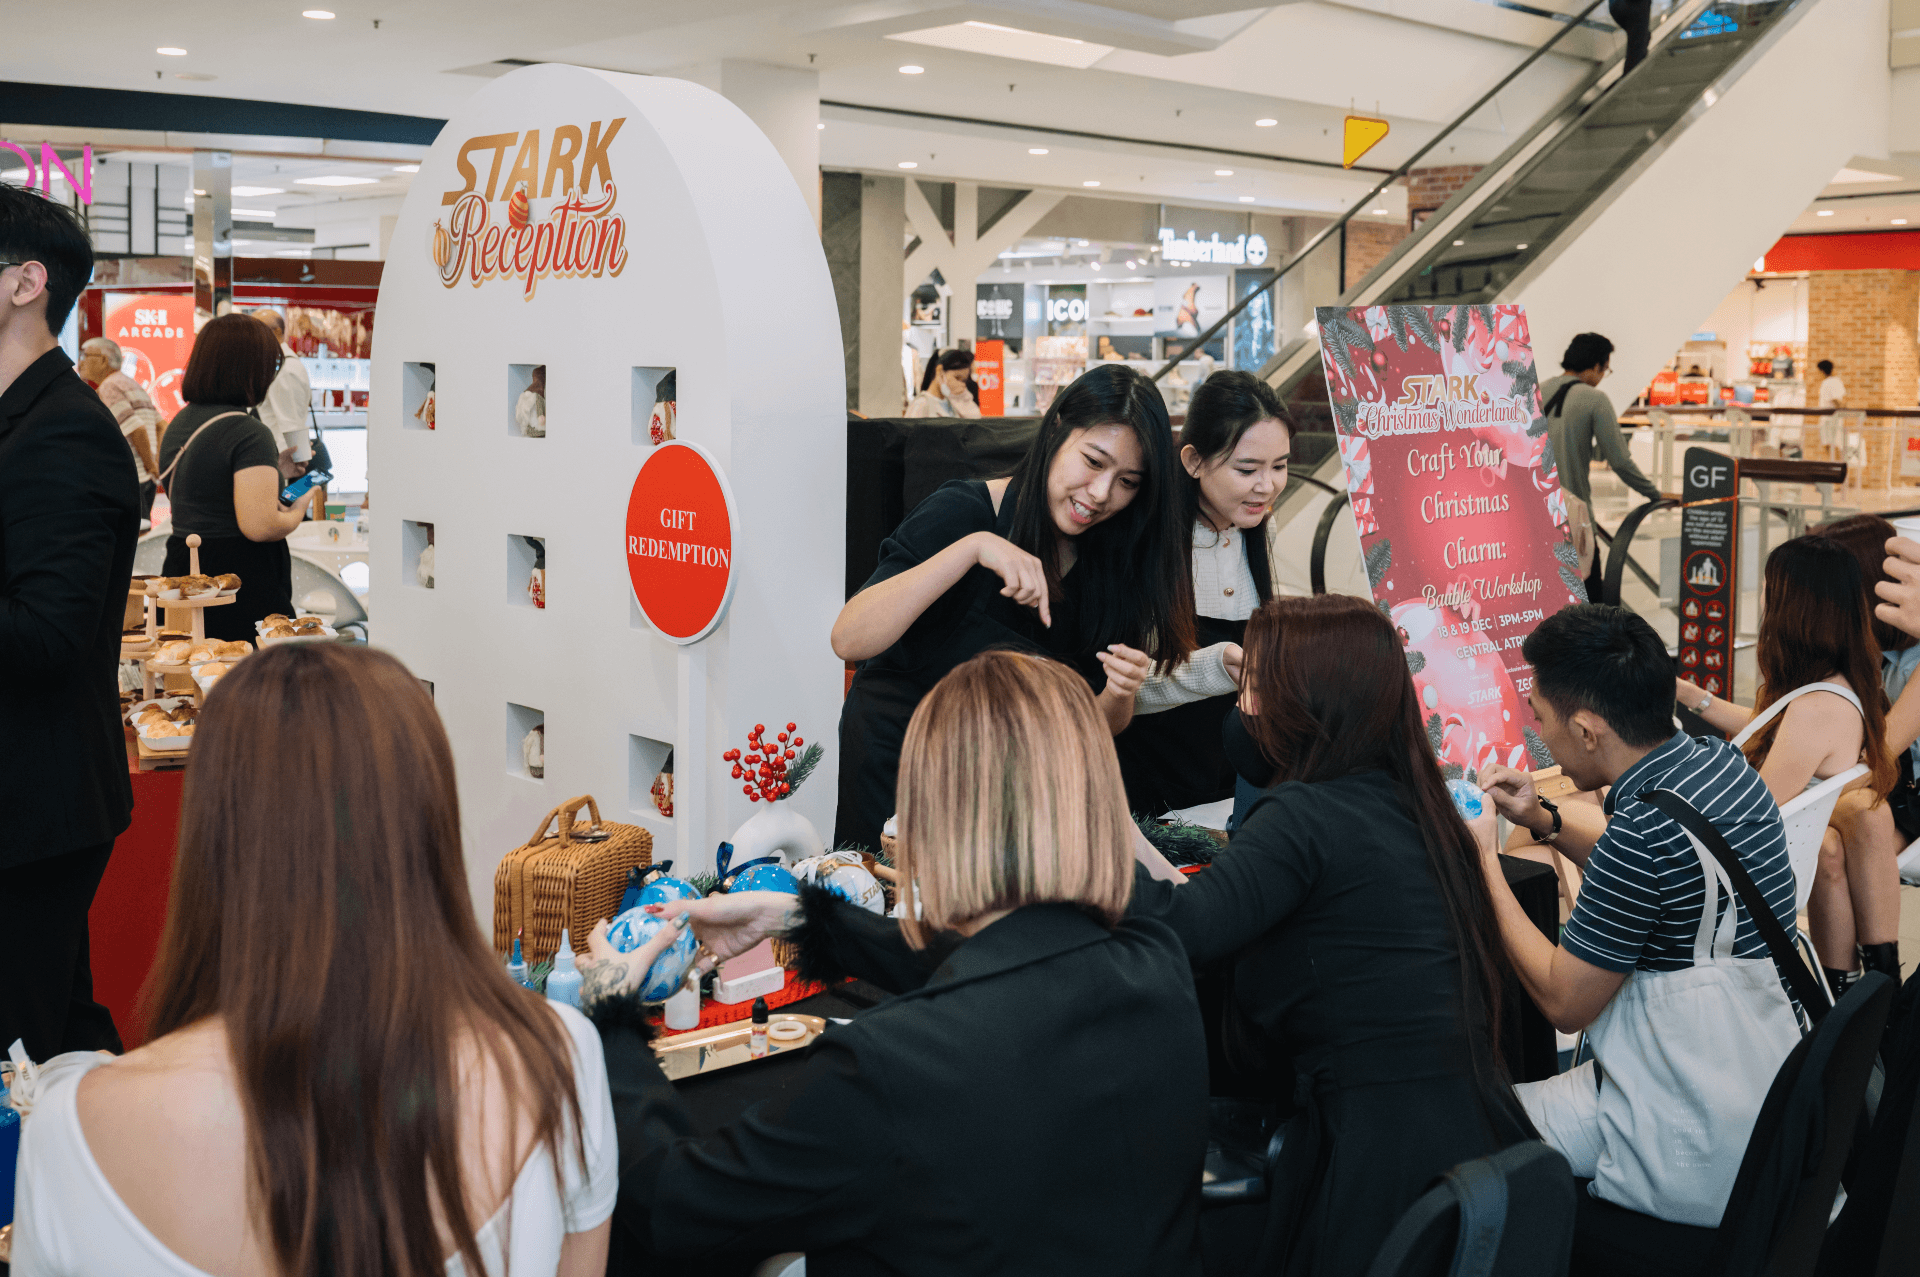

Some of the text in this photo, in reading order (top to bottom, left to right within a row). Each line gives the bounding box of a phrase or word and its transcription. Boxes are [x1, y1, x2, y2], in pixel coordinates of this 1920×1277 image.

[441, 117, 627, 206] STARK
[440, 182, 627, 302] Reception
[119, 326, 184, 339] ARCADE
[1398, 374, 1480, 405] STARK
[1360, 396, 1522, 437] Christmas Wonderland
[1407, 442, 1503, 480] Craft Your
[1689, 465, 1728, 488] GF
[660, 508, 697, 531] GIFT
[1421, 491, 1510, 524] Christmas
[628, 535, 730, 569] REDEMPTION
[1443, 536, 1507, 569] Charm:
[1422, 572, 1543, 610] Bauble Workshop
[1437, 608, 1544, 638] 18 & 19 DEC 3PM-5PM
[1456, 640, 1503, 659] CENTRAL
[1467, 685, 1503, 705] STARK
[862, 881, 882, 905] STAR
